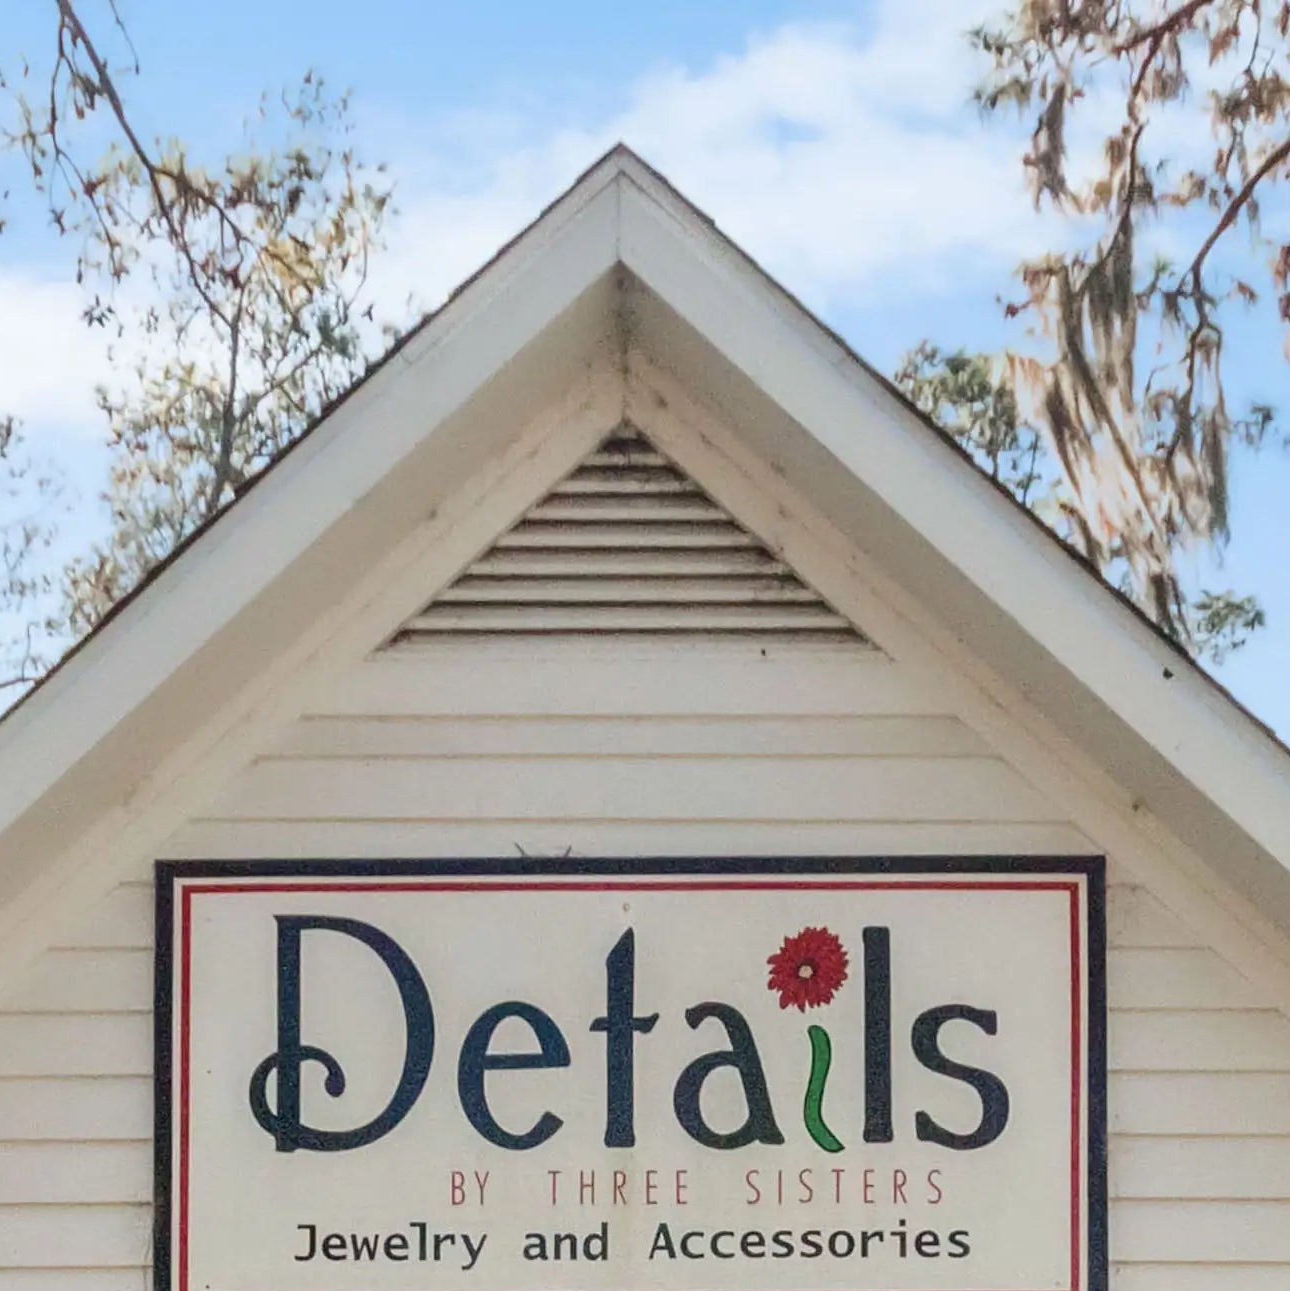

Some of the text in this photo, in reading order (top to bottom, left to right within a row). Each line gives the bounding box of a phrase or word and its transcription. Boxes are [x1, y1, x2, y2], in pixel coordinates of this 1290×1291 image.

[248, 914, 1010, 1153] Details
[451, 1168, 945, 1206] BY THREE SISTERS
[294, 1218, 971, 1271] Jewelry and Accessories
